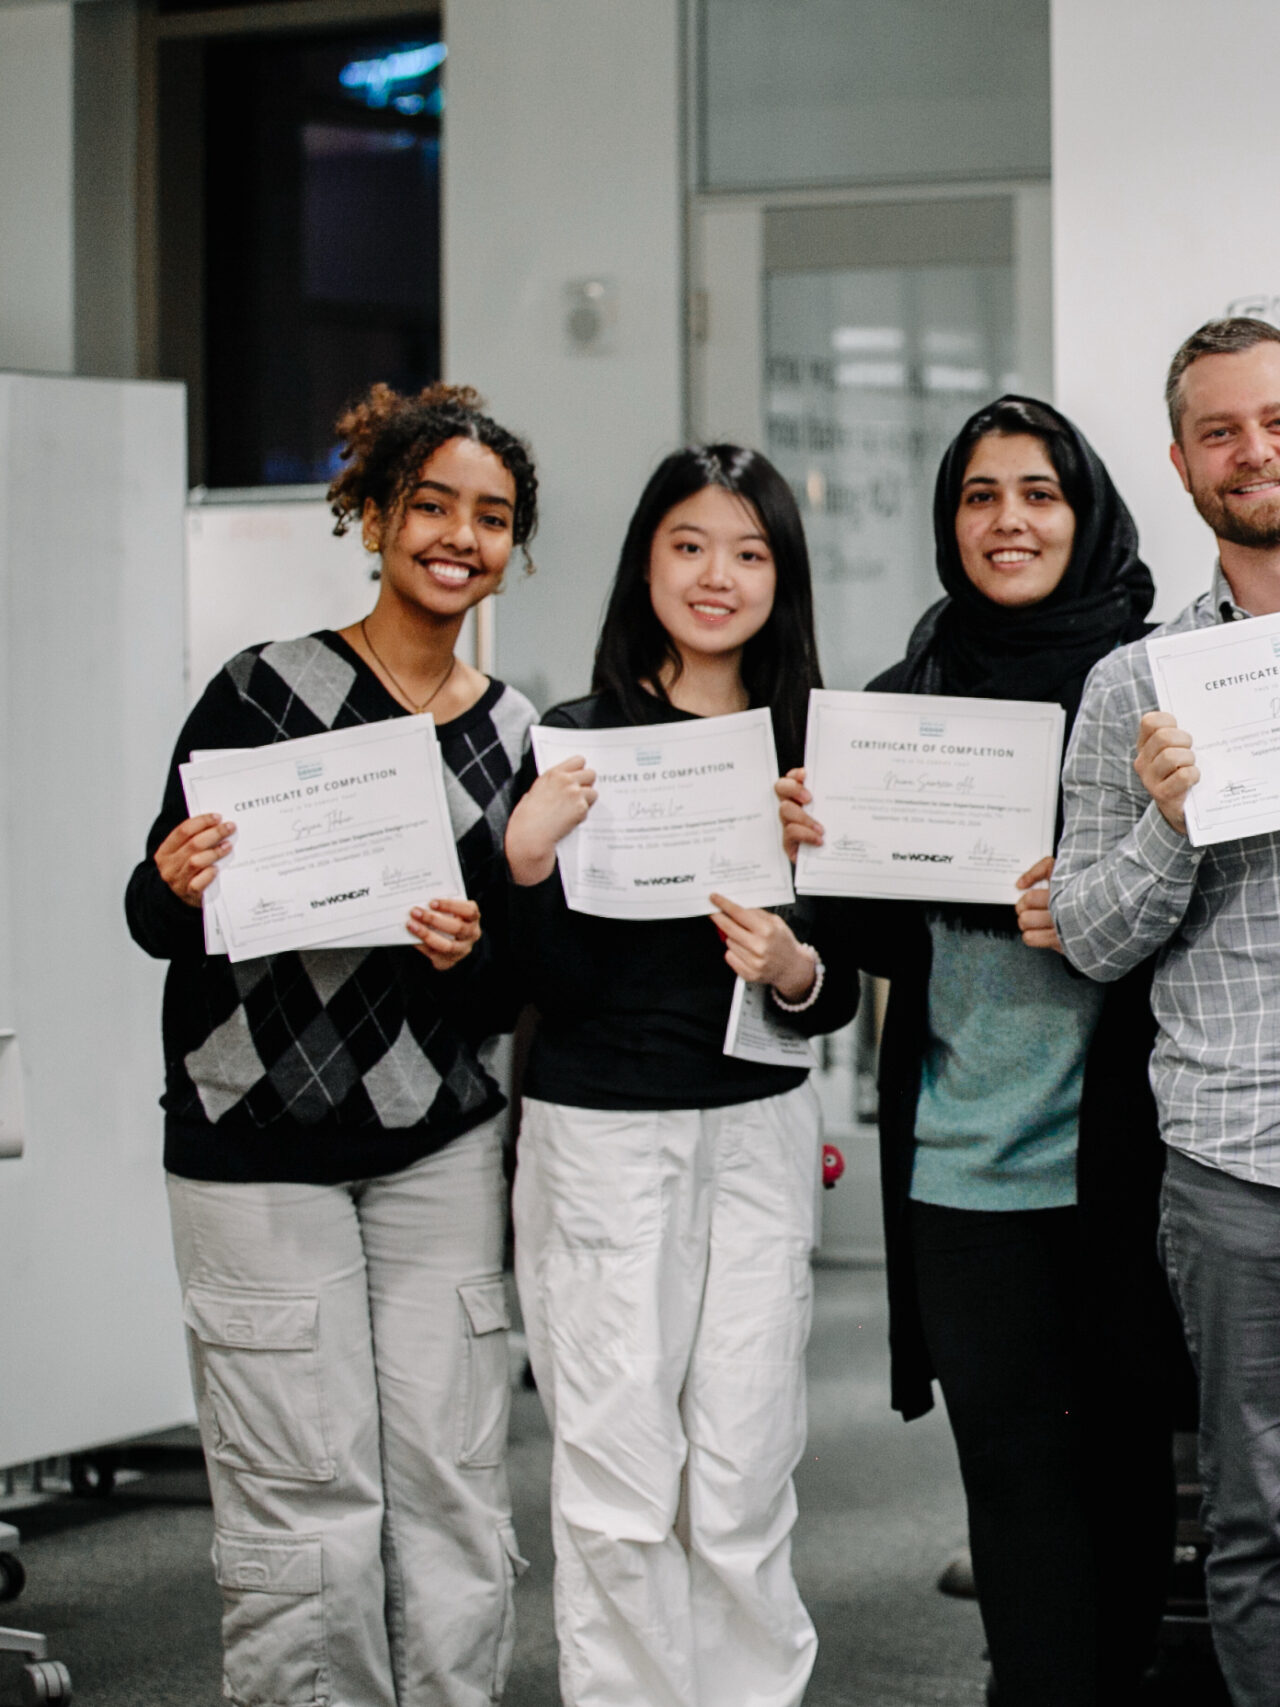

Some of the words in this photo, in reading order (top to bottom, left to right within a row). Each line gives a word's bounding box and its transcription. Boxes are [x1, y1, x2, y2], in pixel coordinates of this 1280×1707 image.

[1204, 666, 1279, 692] CERTIFICATE
[850, 740, 918, 753] CERTIFICATE
[922, 744, 936, 753] OF
[940, 745, 1015, 758] COMPLETION
[599, 773, 639, 783] IFICATE
[642, 771, 657, 782] OF
[661, 762, 735, 780] COMPLETION
[234, 789, 302, 812] CERTIFICATE
[306, 785, 320, 796] OF
[324, 768, 398, 792] COMPLETION
